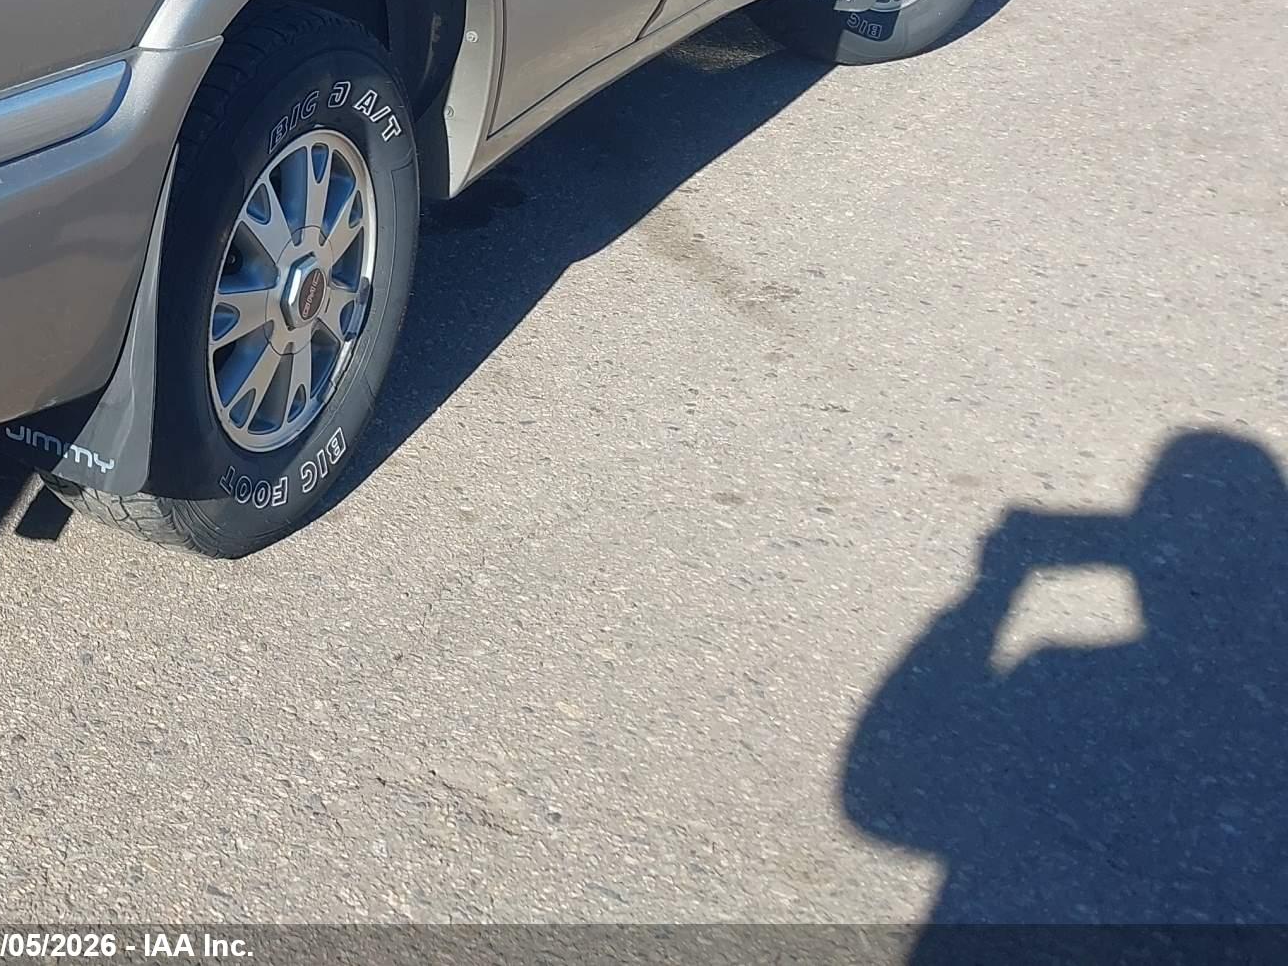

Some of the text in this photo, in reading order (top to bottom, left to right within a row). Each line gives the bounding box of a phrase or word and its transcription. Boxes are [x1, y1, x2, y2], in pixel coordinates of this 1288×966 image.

[269, 90, 320, 155] BIG
[353, 89, 402, 142] A/T
[219, 426, 347, 509] BIG FOOT
